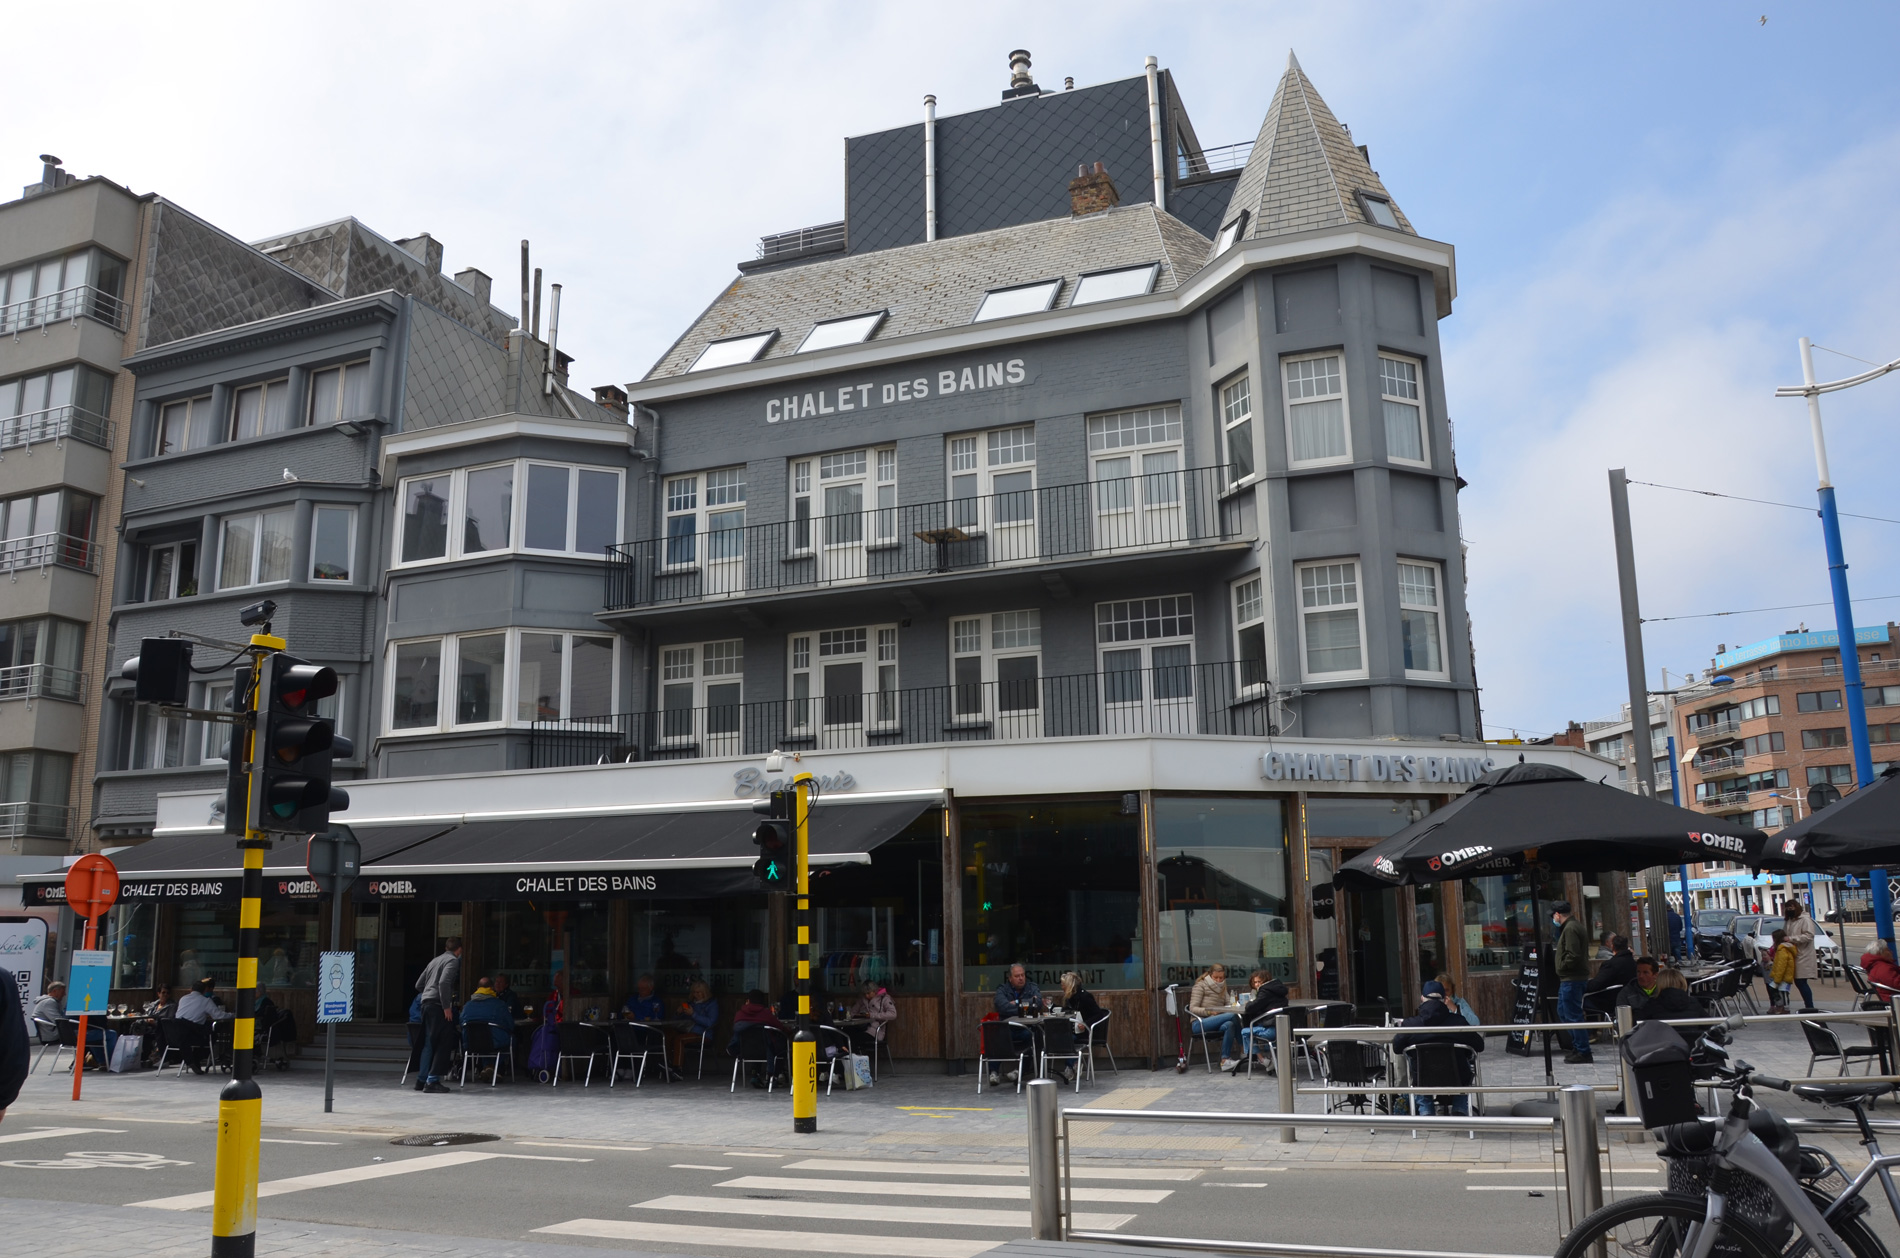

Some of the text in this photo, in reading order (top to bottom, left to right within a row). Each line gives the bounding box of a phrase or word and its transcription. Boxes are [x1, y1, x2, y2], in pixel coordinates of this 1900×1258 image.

[766, 358, 1026, 424] CHALET DES BAINS
[1263, 751, 1362, 781] CHALET
[1370, 754, 1418, 782] DES
[733, 767, 857, 798] Braerie
[1702, 832, 1747, 854] OMER.
[1440, 845, 1493, 866] OMER.
[122, 882, 222, 897] CHALET DES BAINS
[287, 880, 320, 894] OMER.
[379, 880, 416, 894] OMER.
[516, 875, 657, 892] CHALET DES BAINS
[45, 886, 67, 899] OME
[1004, 969, 1105, 984] RSTAUANT
